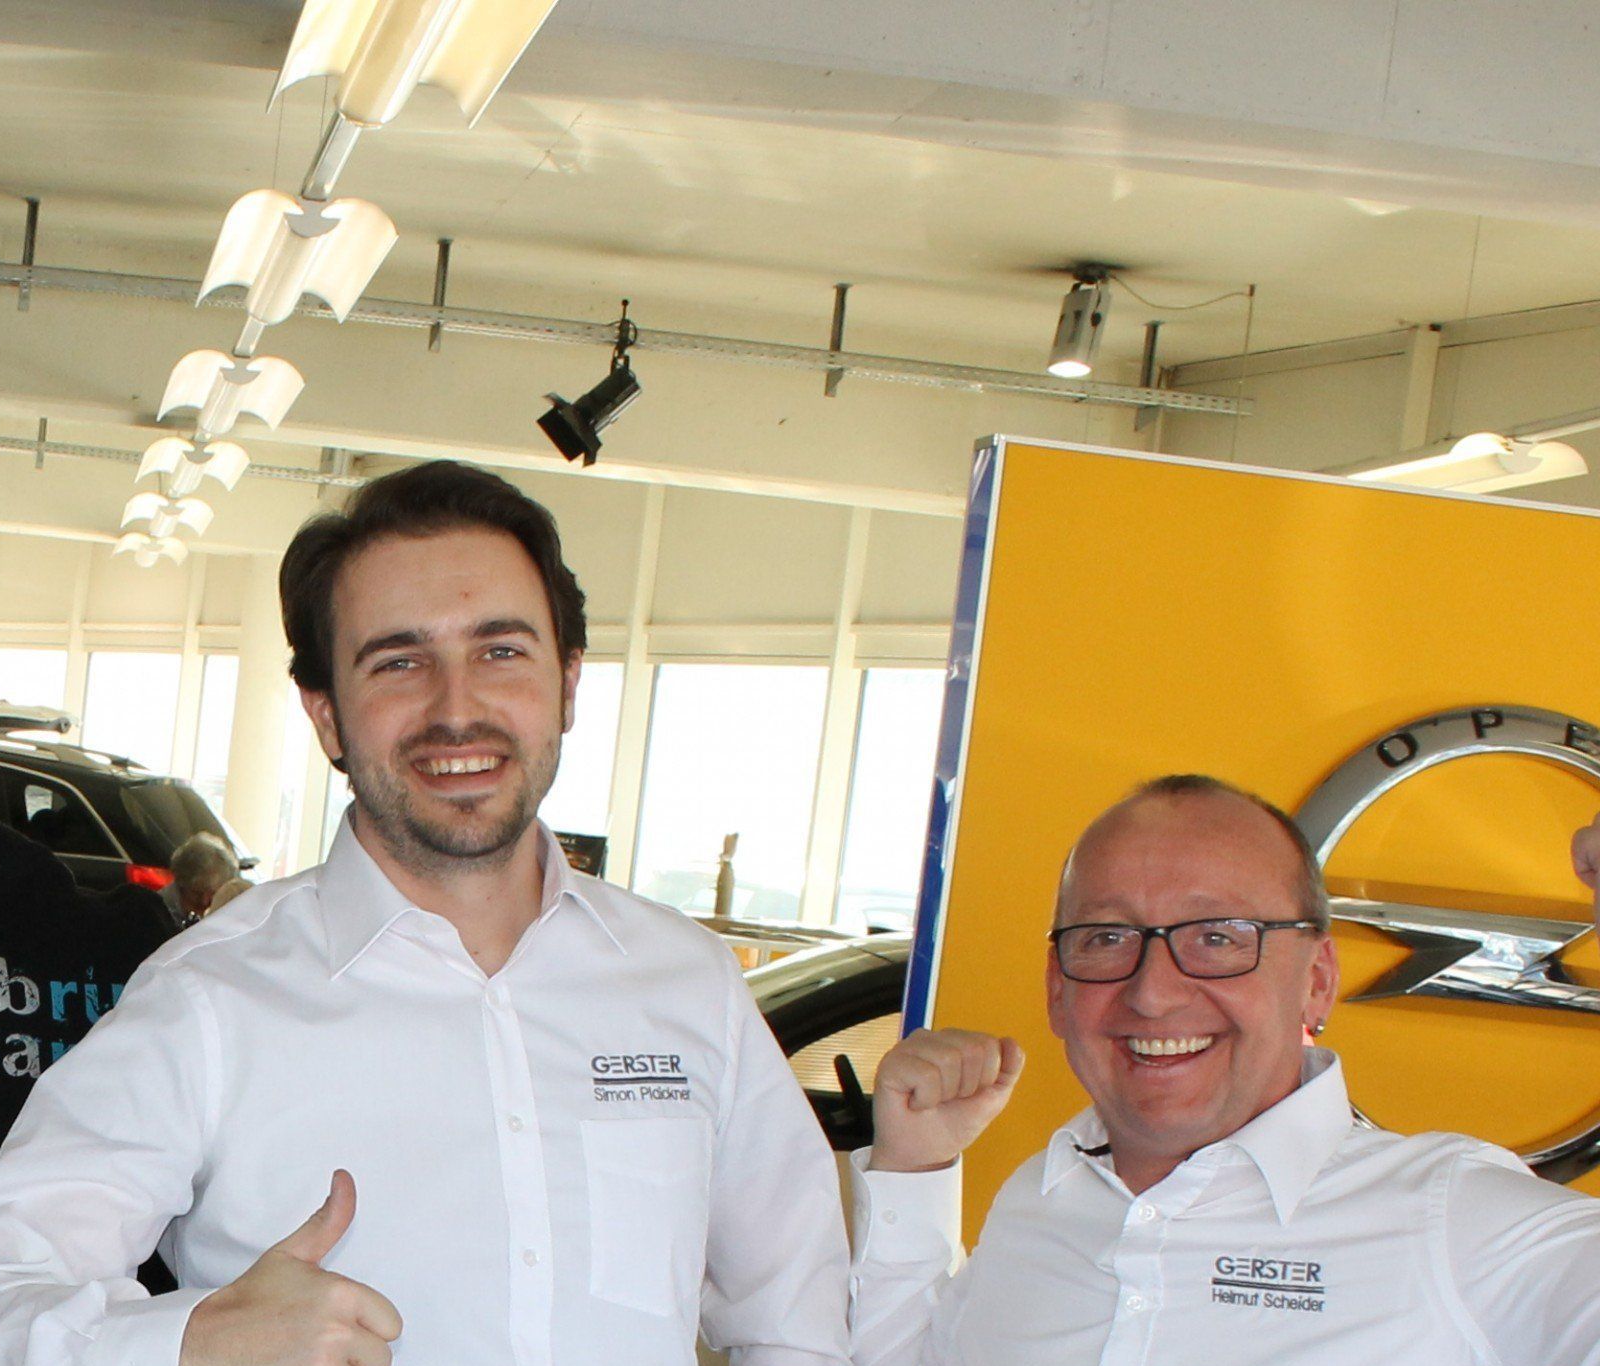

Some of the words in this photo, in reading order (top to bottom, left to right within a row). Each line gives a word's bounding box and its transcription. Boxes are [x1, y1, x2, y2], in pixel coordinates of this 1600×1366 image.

[591, 1054, 682, 1073] GERSTER
[593, 1086, 636, 1101] Simon
[1215, 1256, 1322, 1282] GERSTER
[1211, 1287, 1260, 1306] Helmut
[1263, 1292, 1325, 1312] Scheider
